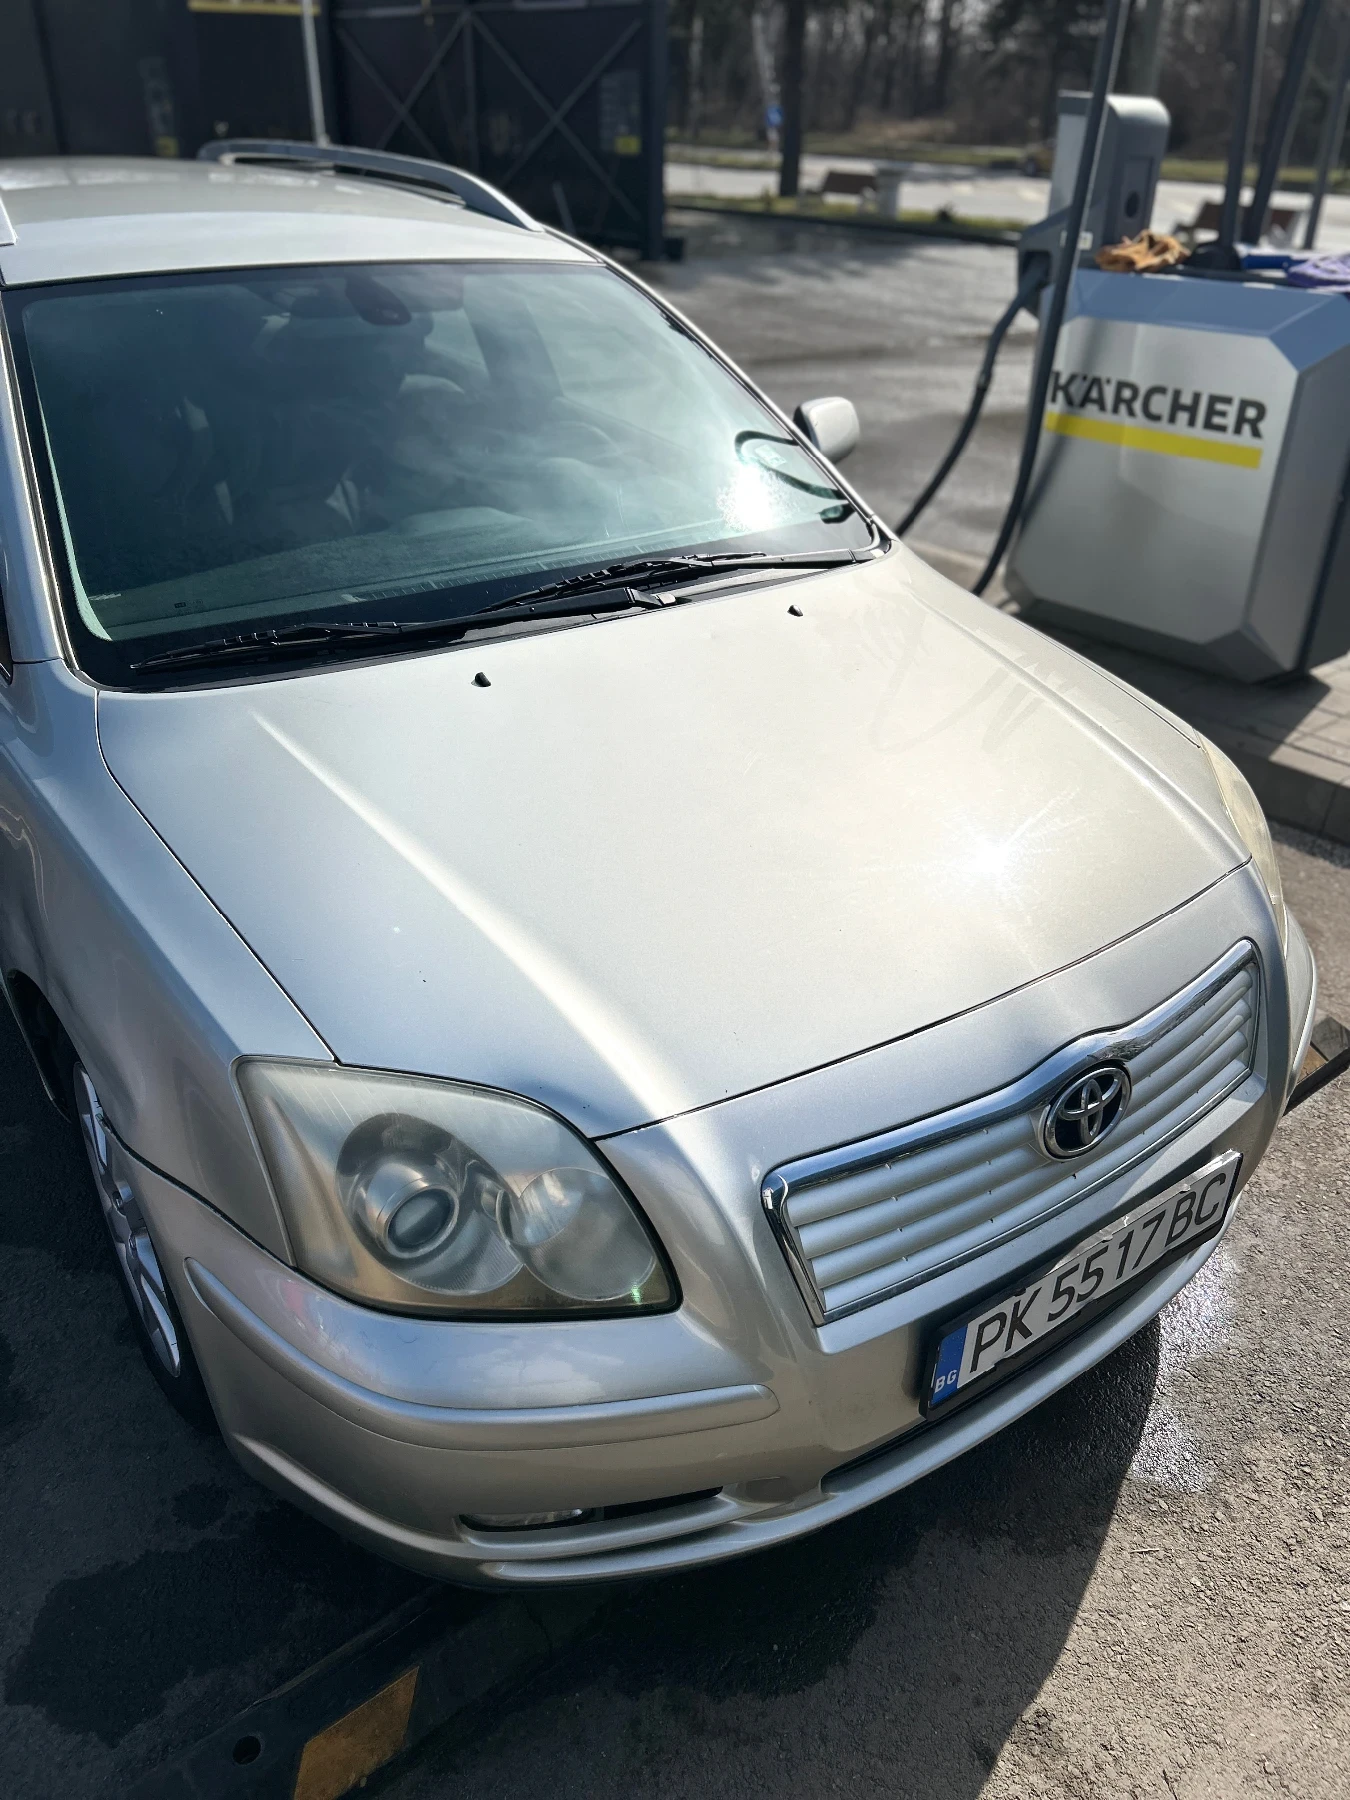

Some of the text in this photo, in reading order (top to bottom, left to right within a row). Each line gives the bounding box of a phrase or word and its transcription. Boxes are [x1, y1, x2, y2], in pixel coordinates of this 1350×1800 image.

[1050, 370, 1267, 440] KÄRCHER
[970, 1286, 1042, 1373] PK
[935, 1370, 957, 1393] BG
